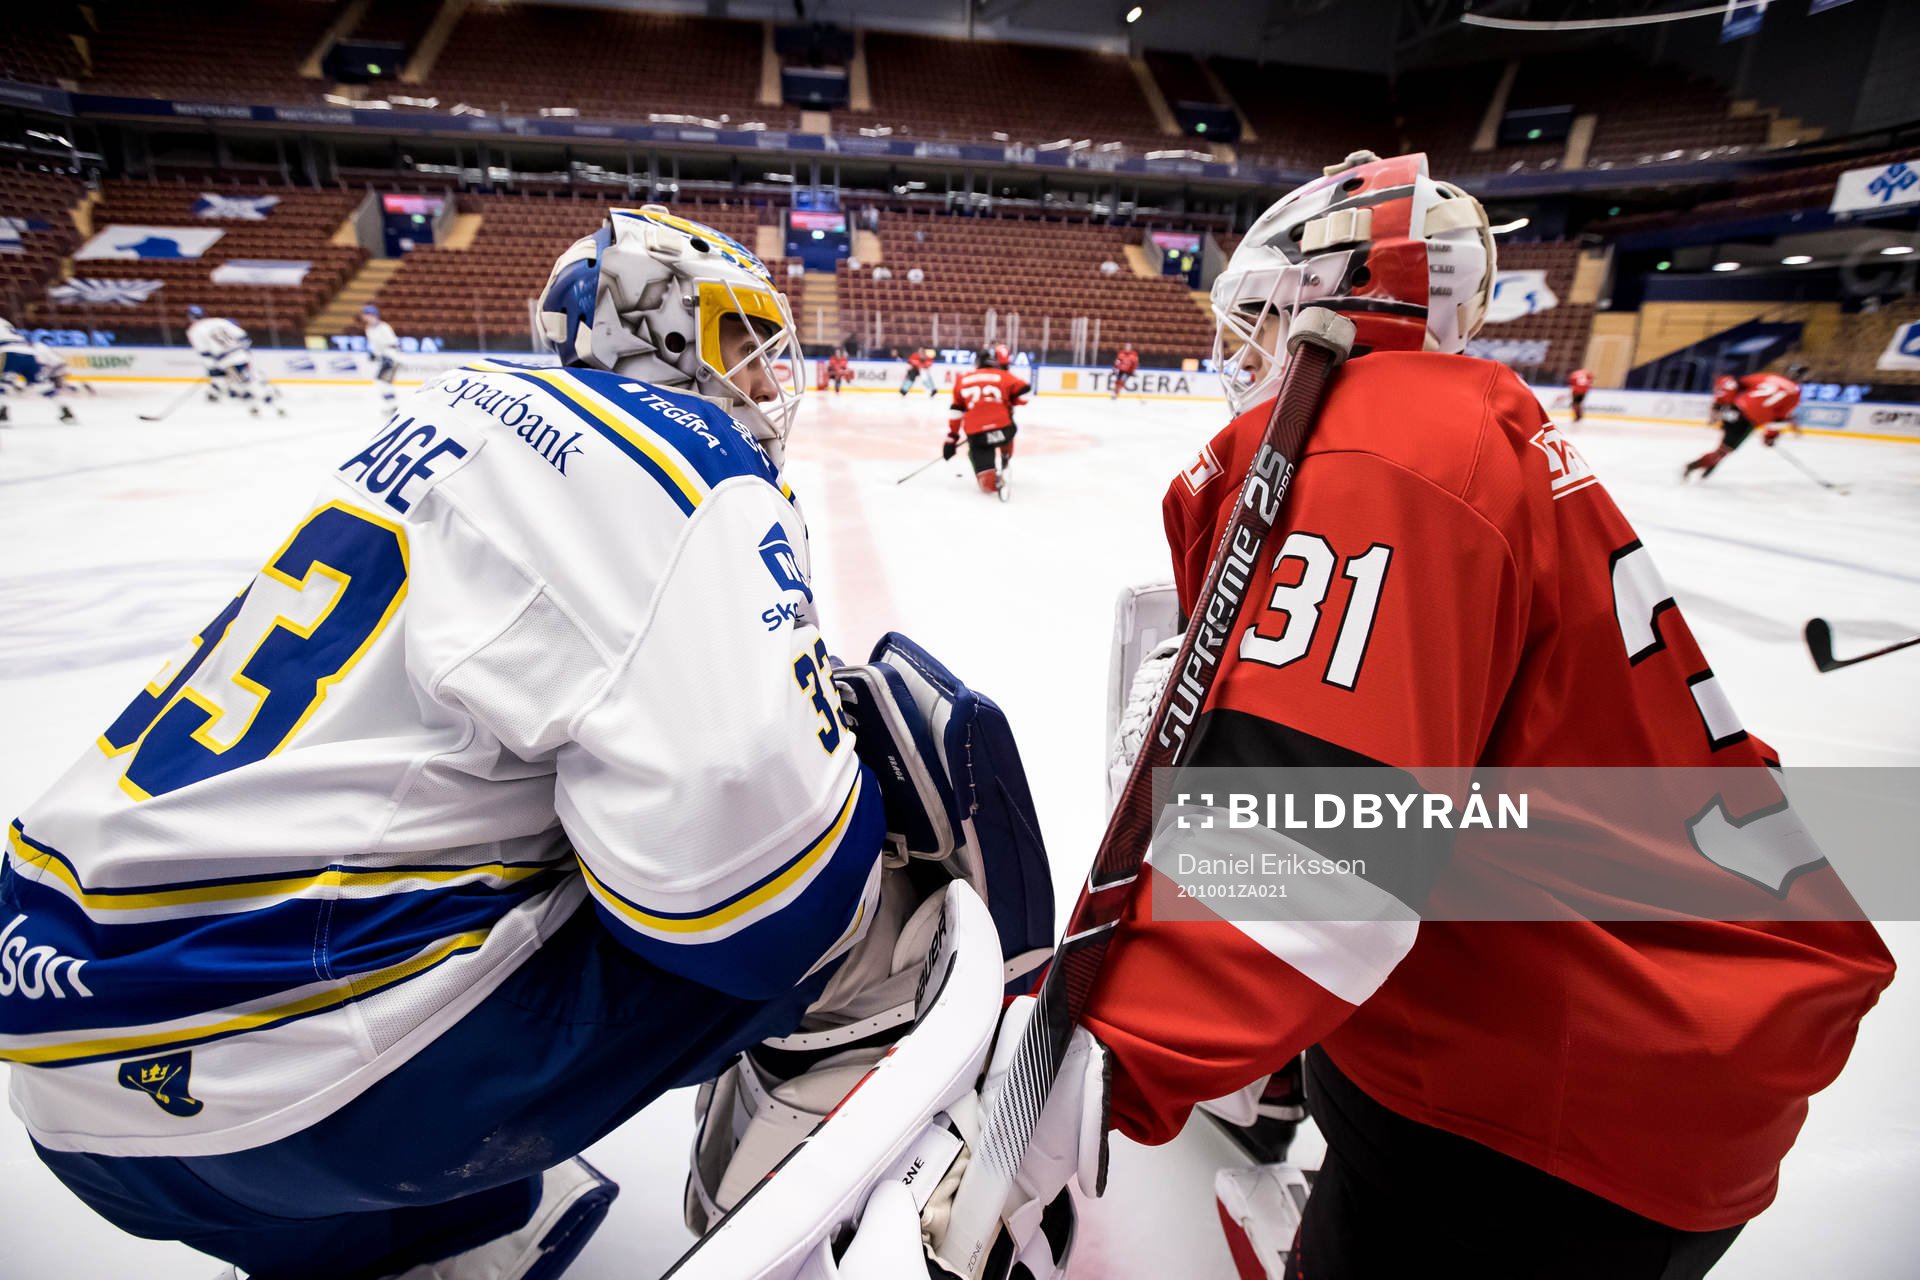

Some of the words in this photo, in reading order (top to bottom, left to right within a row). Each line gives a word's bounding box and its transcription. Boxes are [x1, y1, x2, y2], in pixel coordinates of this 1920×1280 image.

[640, 393, 720, 449] TEGERA
[339, 414, 468, 514] AGE
[1239, 530, 1394, 693] 31
[967, 1239, 984, 1273] ZONE
